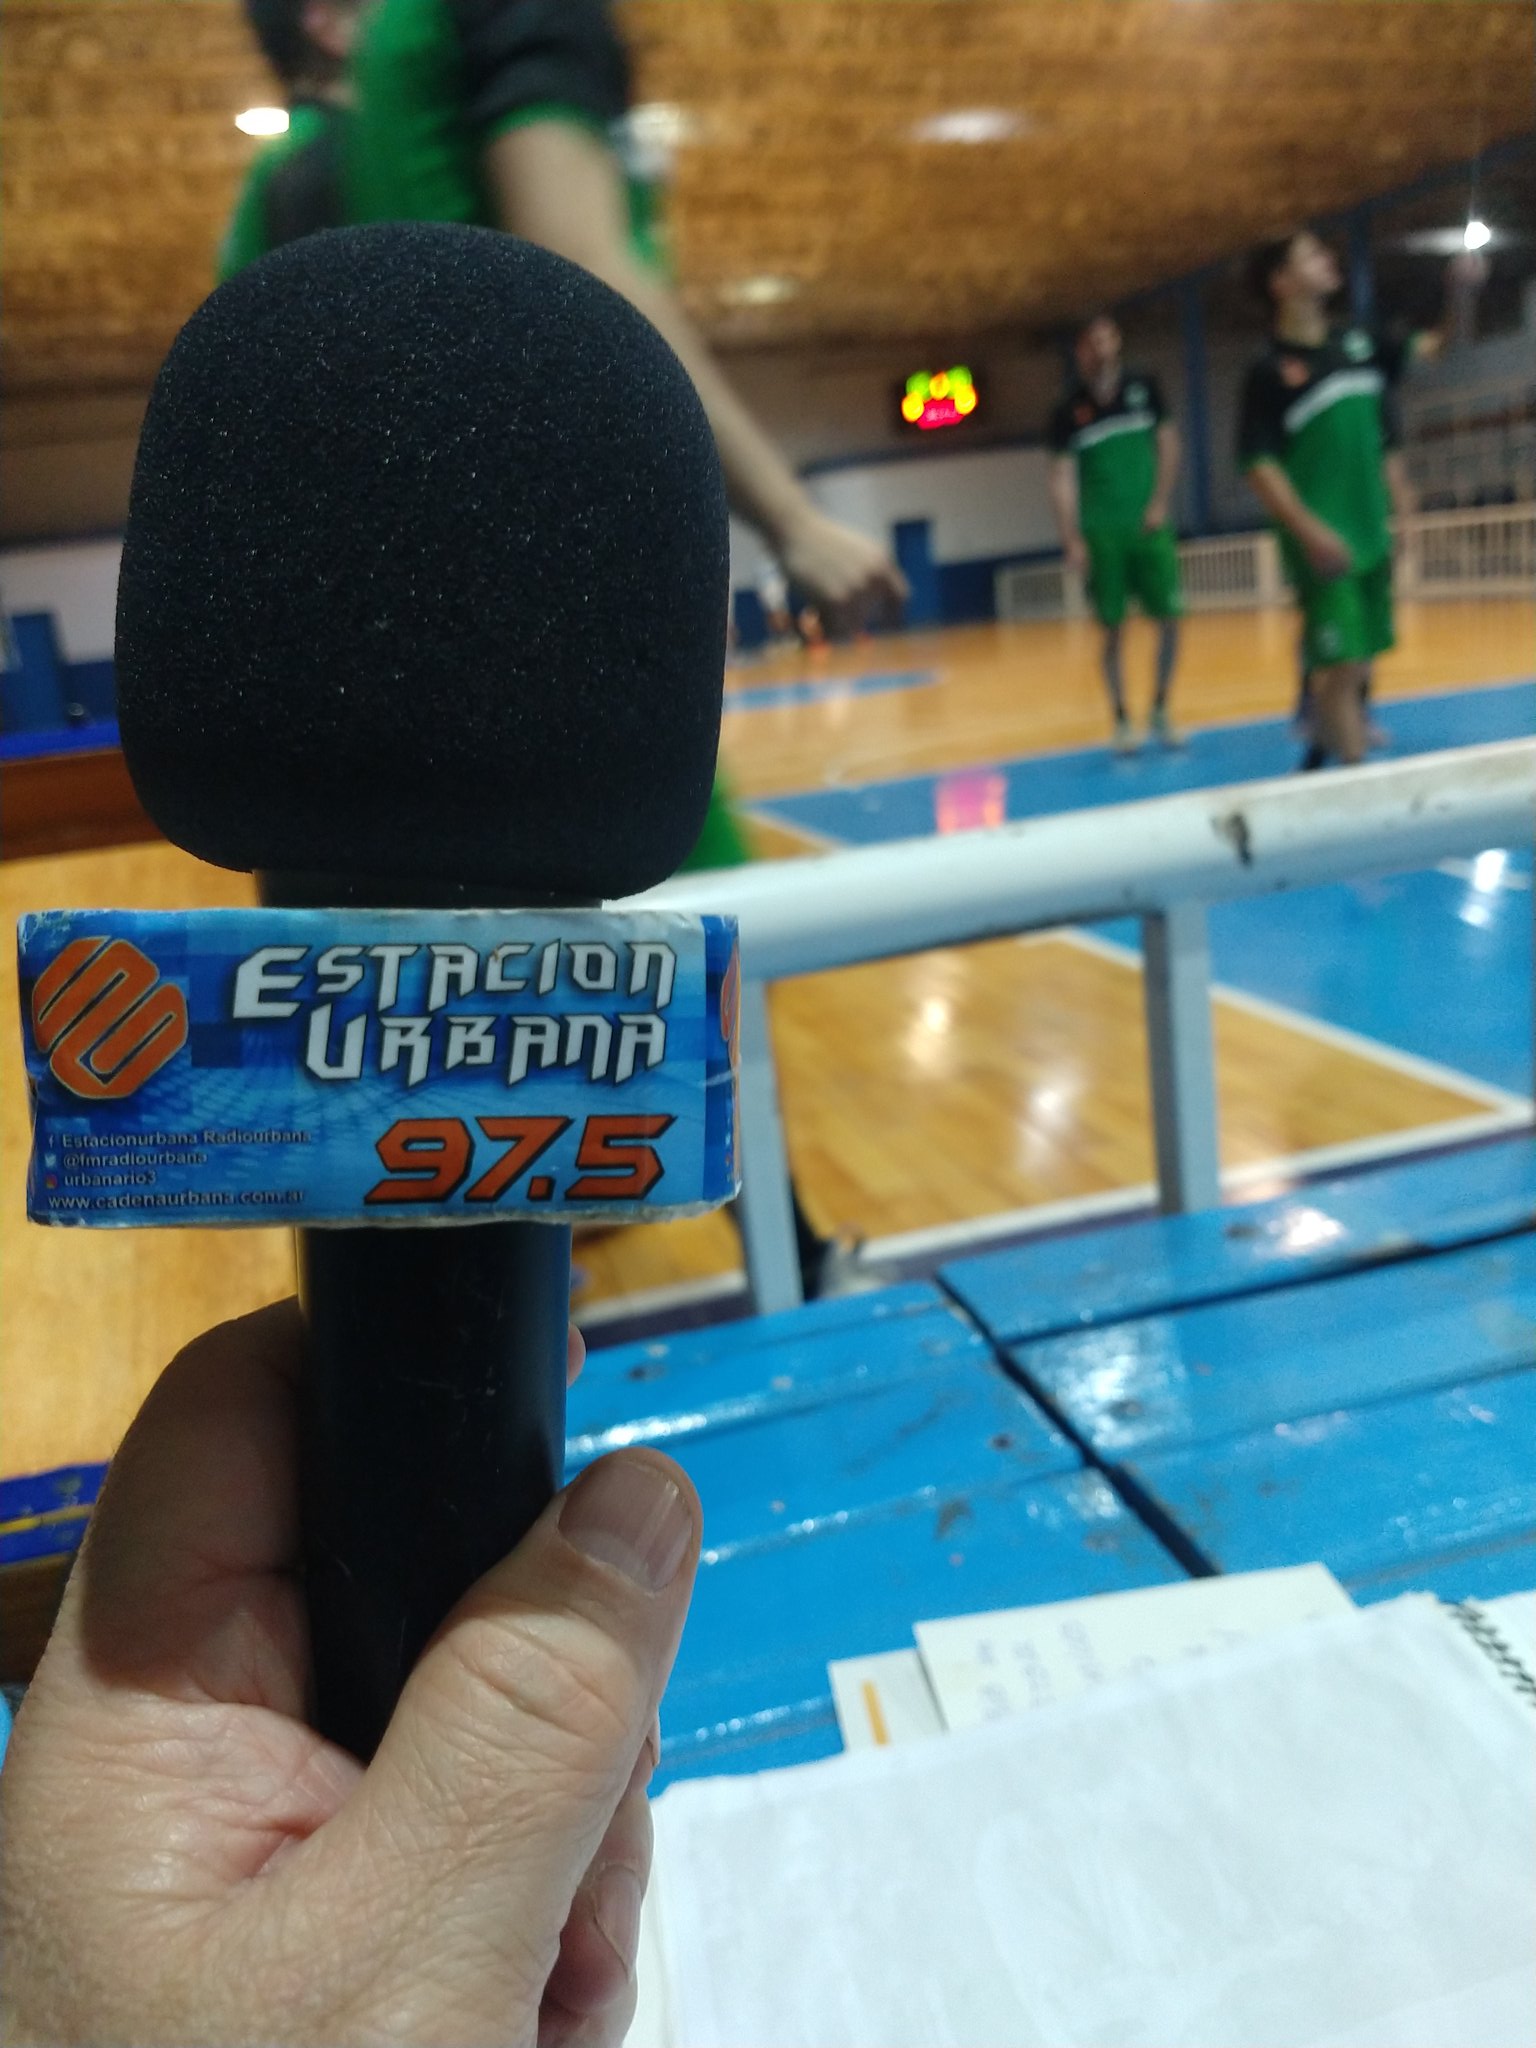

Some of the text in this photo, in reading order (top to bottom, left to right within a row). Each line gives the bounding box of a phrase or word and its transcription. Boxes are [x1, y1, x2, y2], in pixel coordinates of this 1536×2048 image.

[232, 937, 677, 1019] ESTACION
[306, 1003, 667, 1087] URBANA
[62, 1132, 198, 1148] Estacionurbana
[203, 1129, 311, 1144] Radiourbana
[63, 1151, 208, 1169] @fmradiourbana
[364, 1114, 677, 1205] 97.5
[64, 1170, 156, 1186] urbanario3
